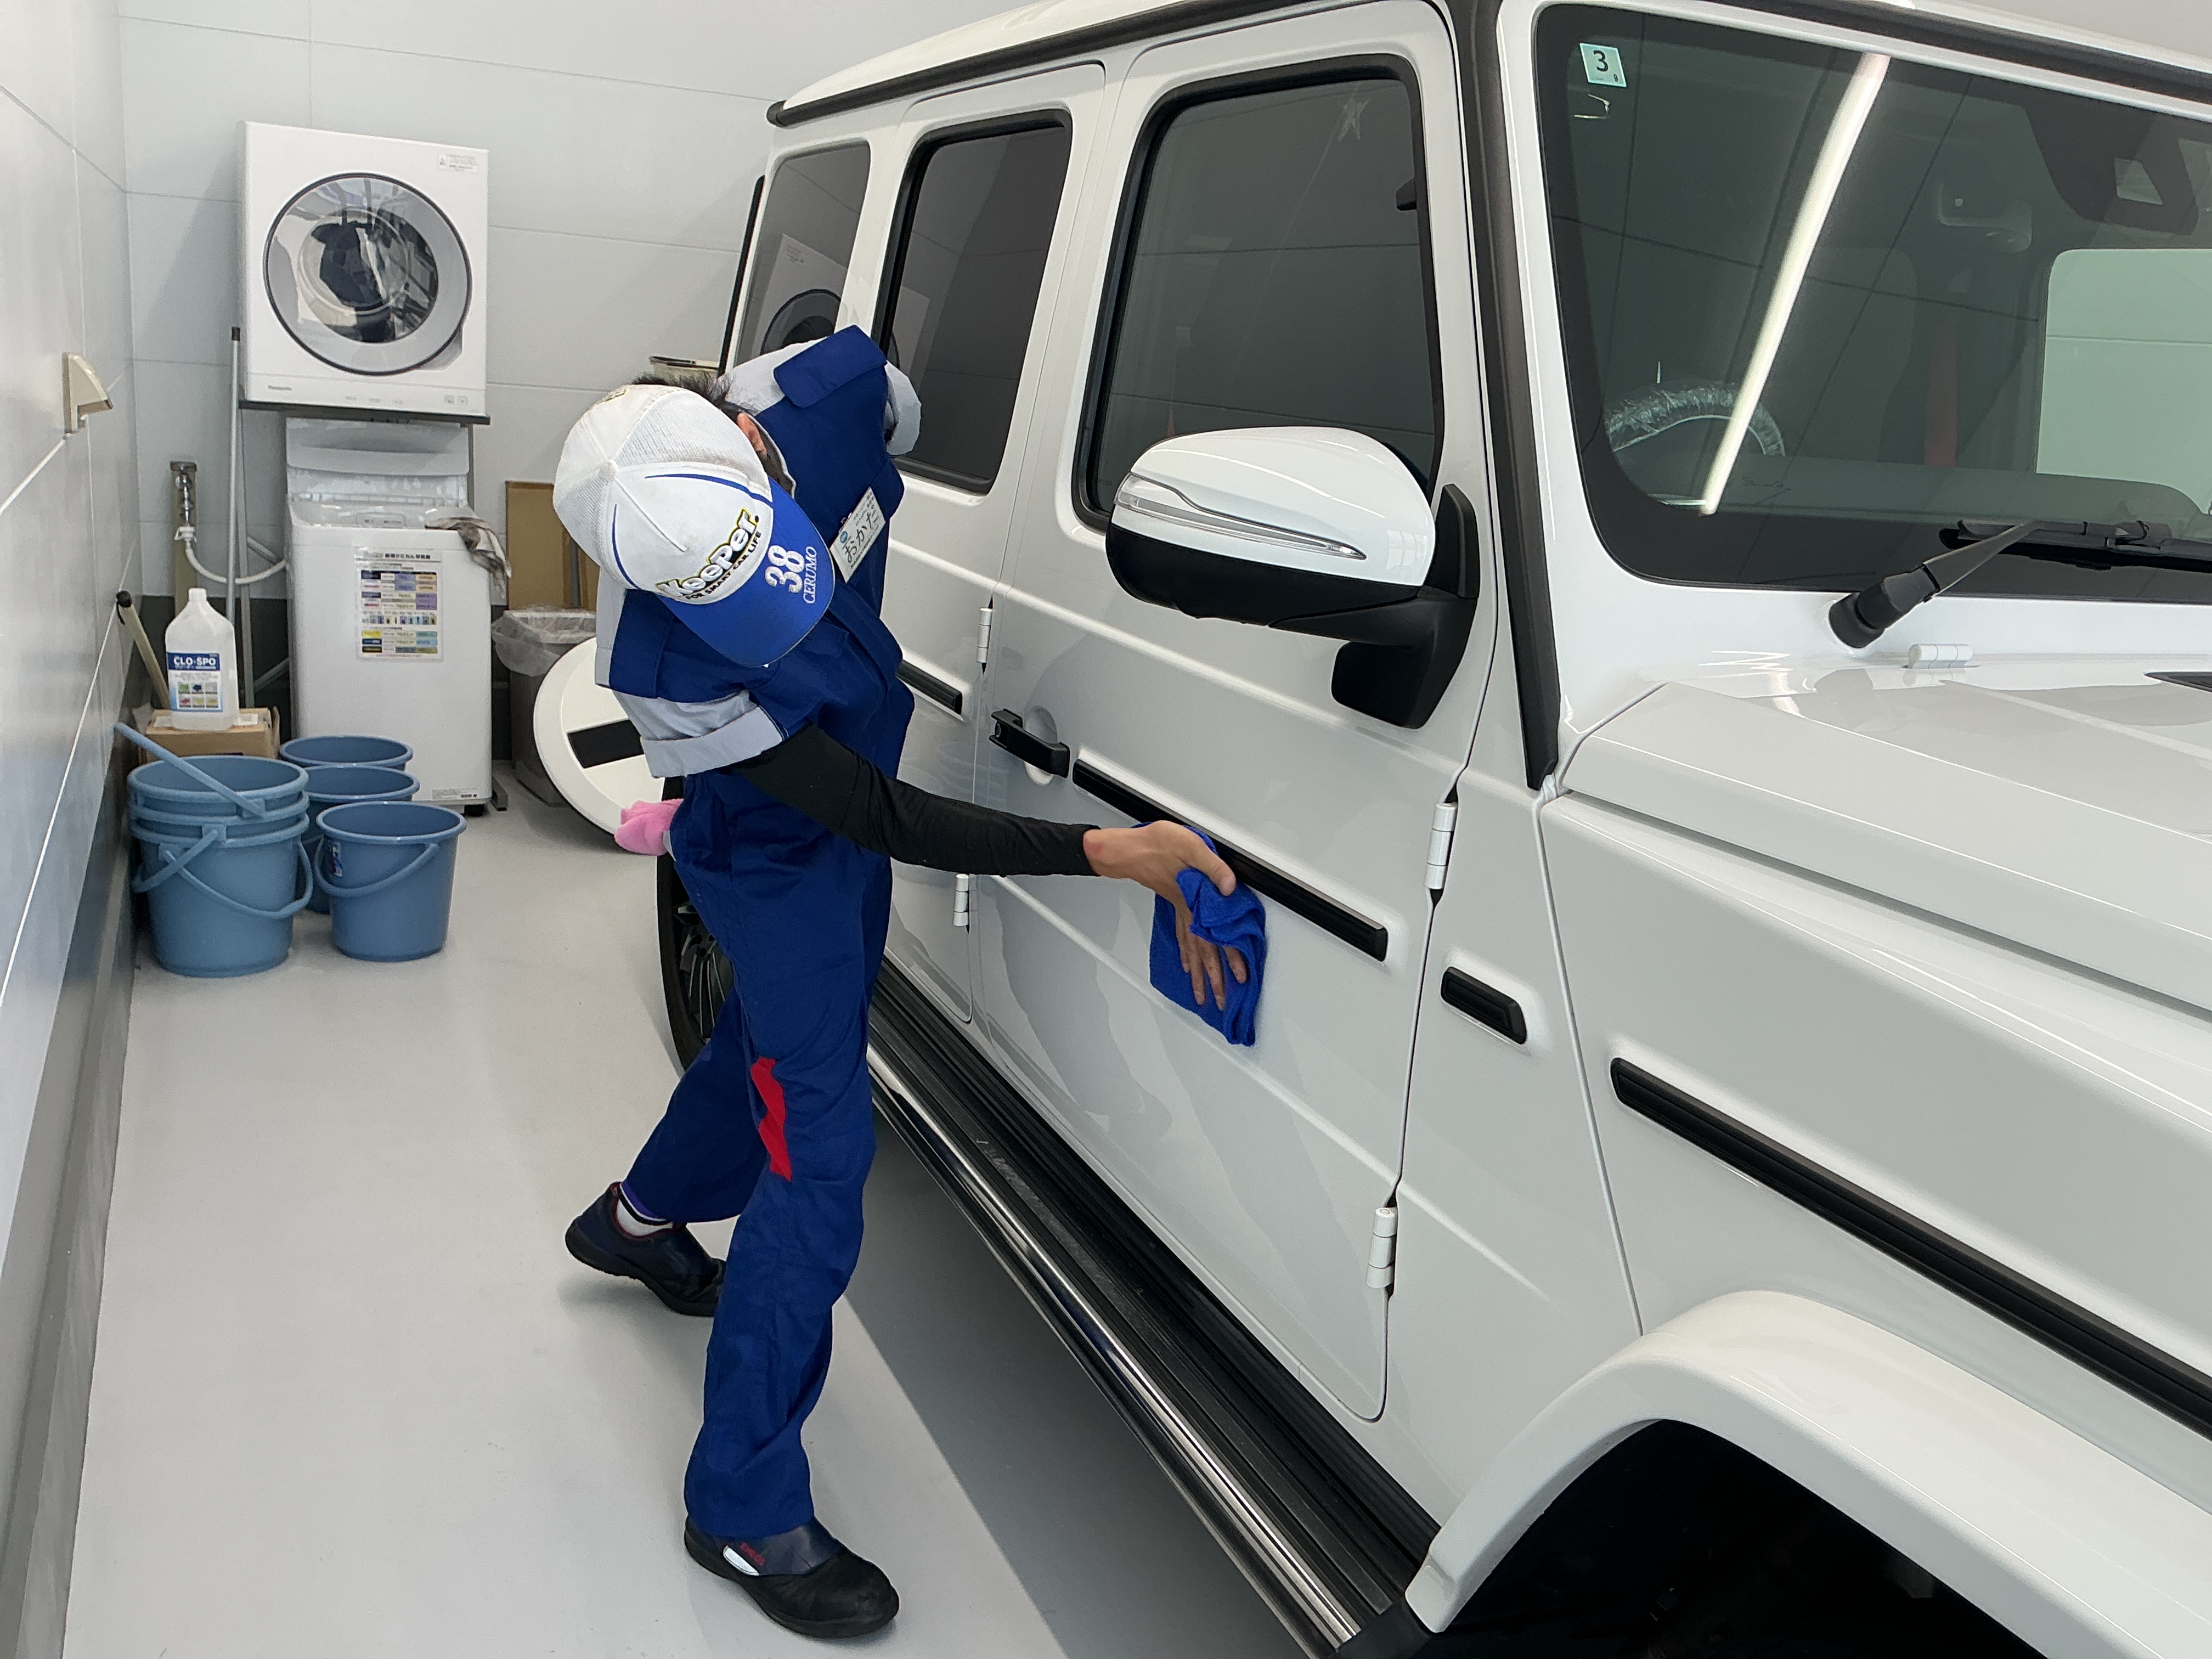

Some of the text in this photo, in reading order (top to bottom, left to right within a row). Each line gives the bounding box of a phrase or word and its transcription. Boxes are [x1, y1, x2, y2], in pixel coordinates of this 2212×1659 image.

[1593, 50, 1609, 72] 3
[842, 504, 879, 563] おかだ
[685, 531, 762, 600] FOR SMART CAR LIFE
[764, 545, 805, 594] 38
[803, 546, 817, 604] CERUMO
